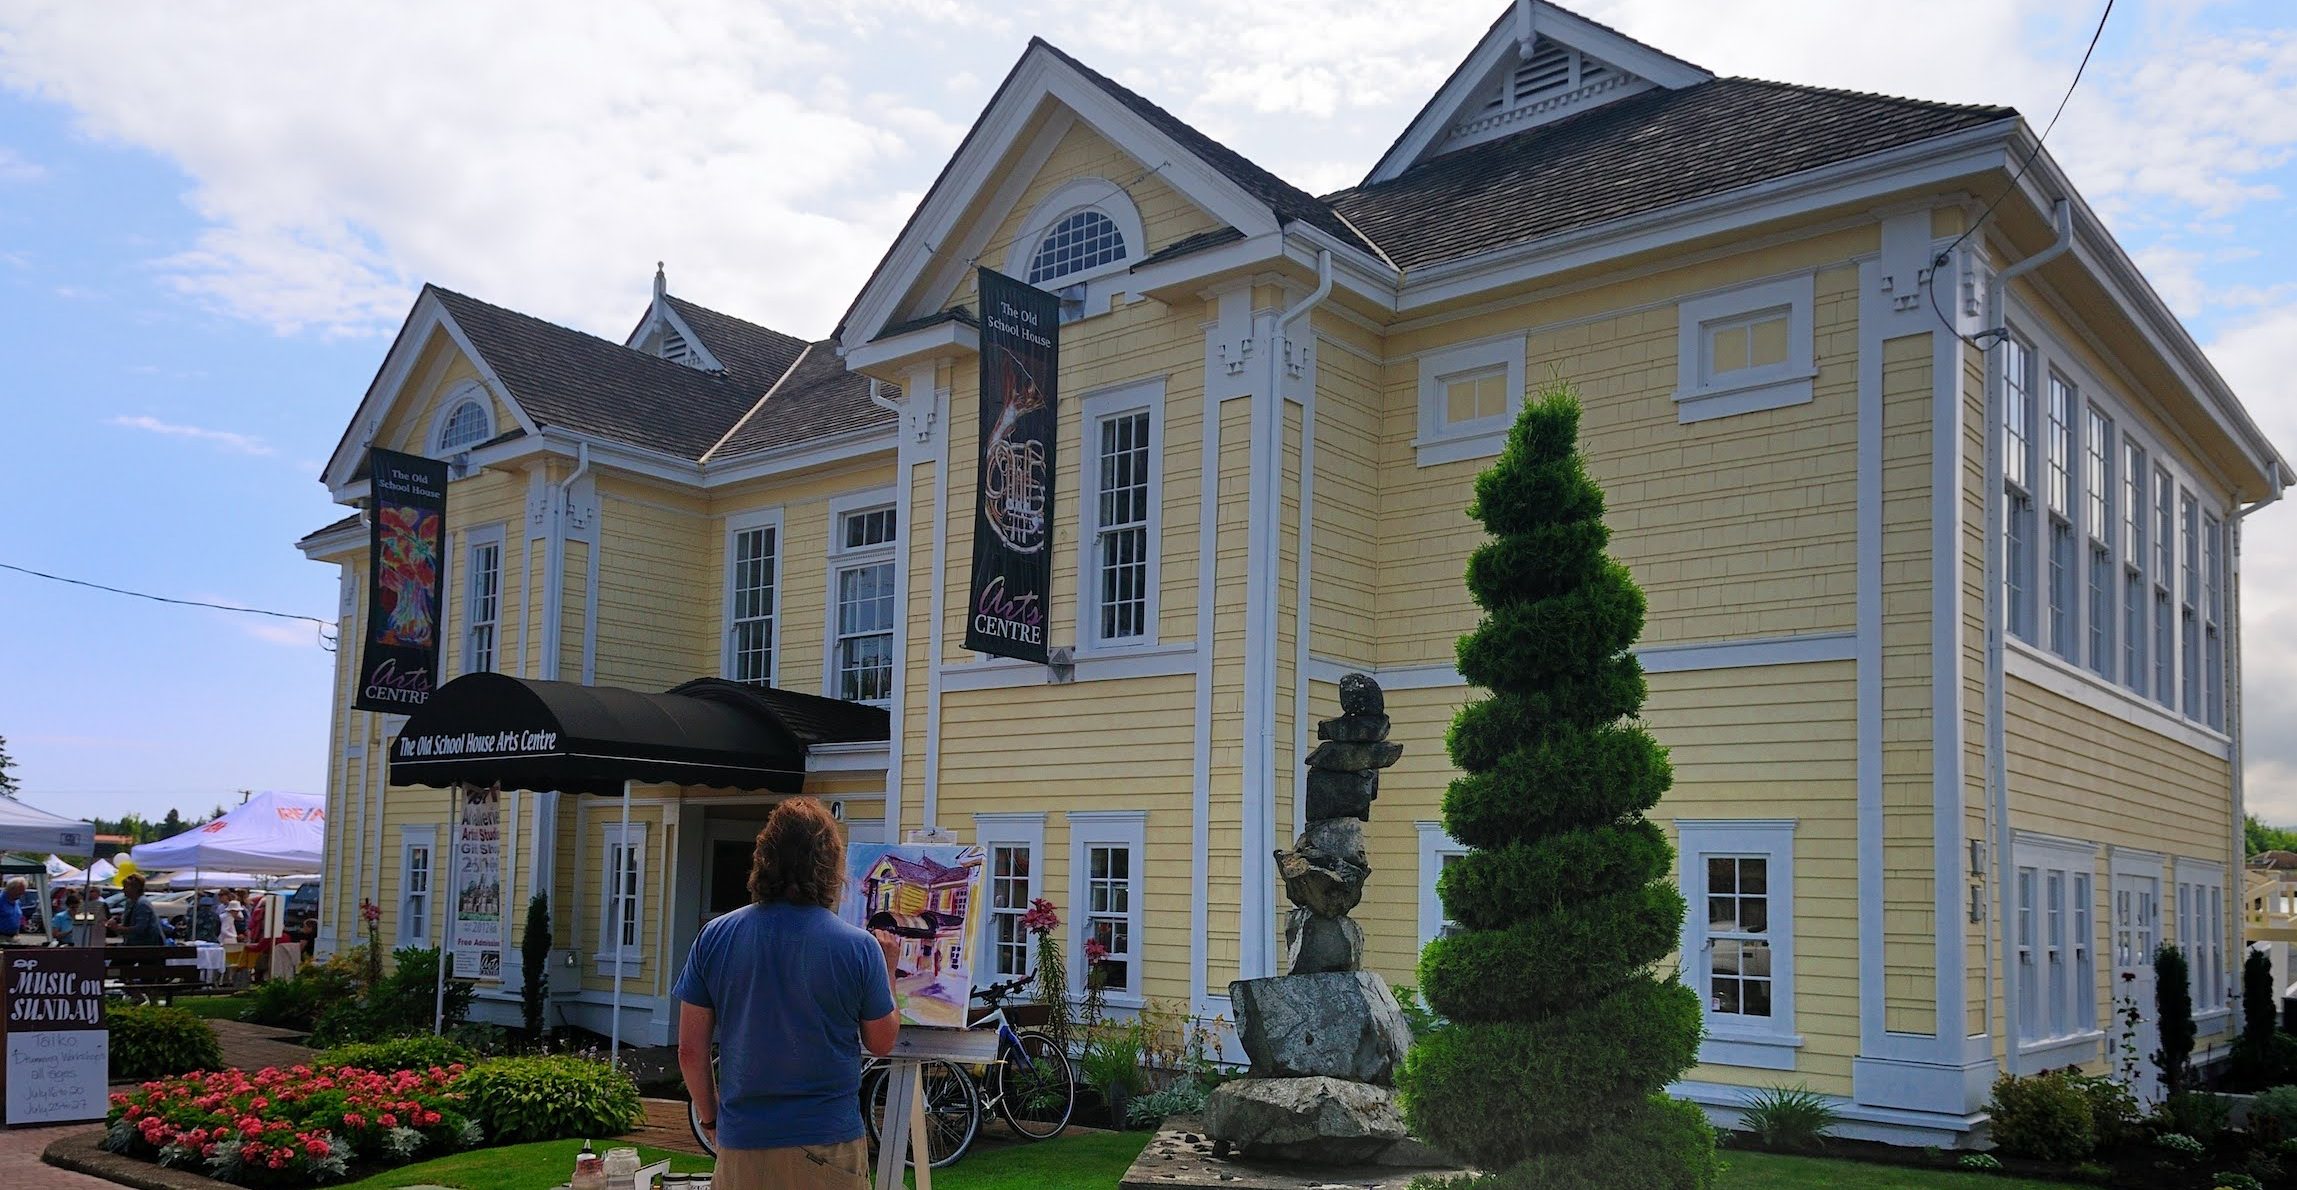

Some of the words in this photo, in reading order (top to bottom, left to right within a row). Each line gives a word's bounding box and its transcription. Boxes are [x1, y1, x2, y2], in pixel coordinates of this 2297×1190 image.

[1000, 301, 1019, 319] The
[1021, 310, 1038, 326] Old
[987, 315, 1020, 337] School
[1021, 327, 1051, 348] House
[378, 479, 410, 493] School
[412, 485, 441, 499] House
[392, 469, 410, 481] The
[411, 473, 428, 484] Old
[974, 613, 1041, 645] CENTRE
[365, 685, 430, 705] CENTRE
[400, 736, 415, 756] The
[416, 735, 432, 756] Old
[433, 733, 466, 755] School
[466, 732, 495, 753] House
[498, 730, 518, 752] Arts
[520, 729, 557, 751] Centre
[9, 971, 78, 995] MUSIC
[80, 979, 102, 996] on
[10, 997, 100, 1025] SUNDAY
